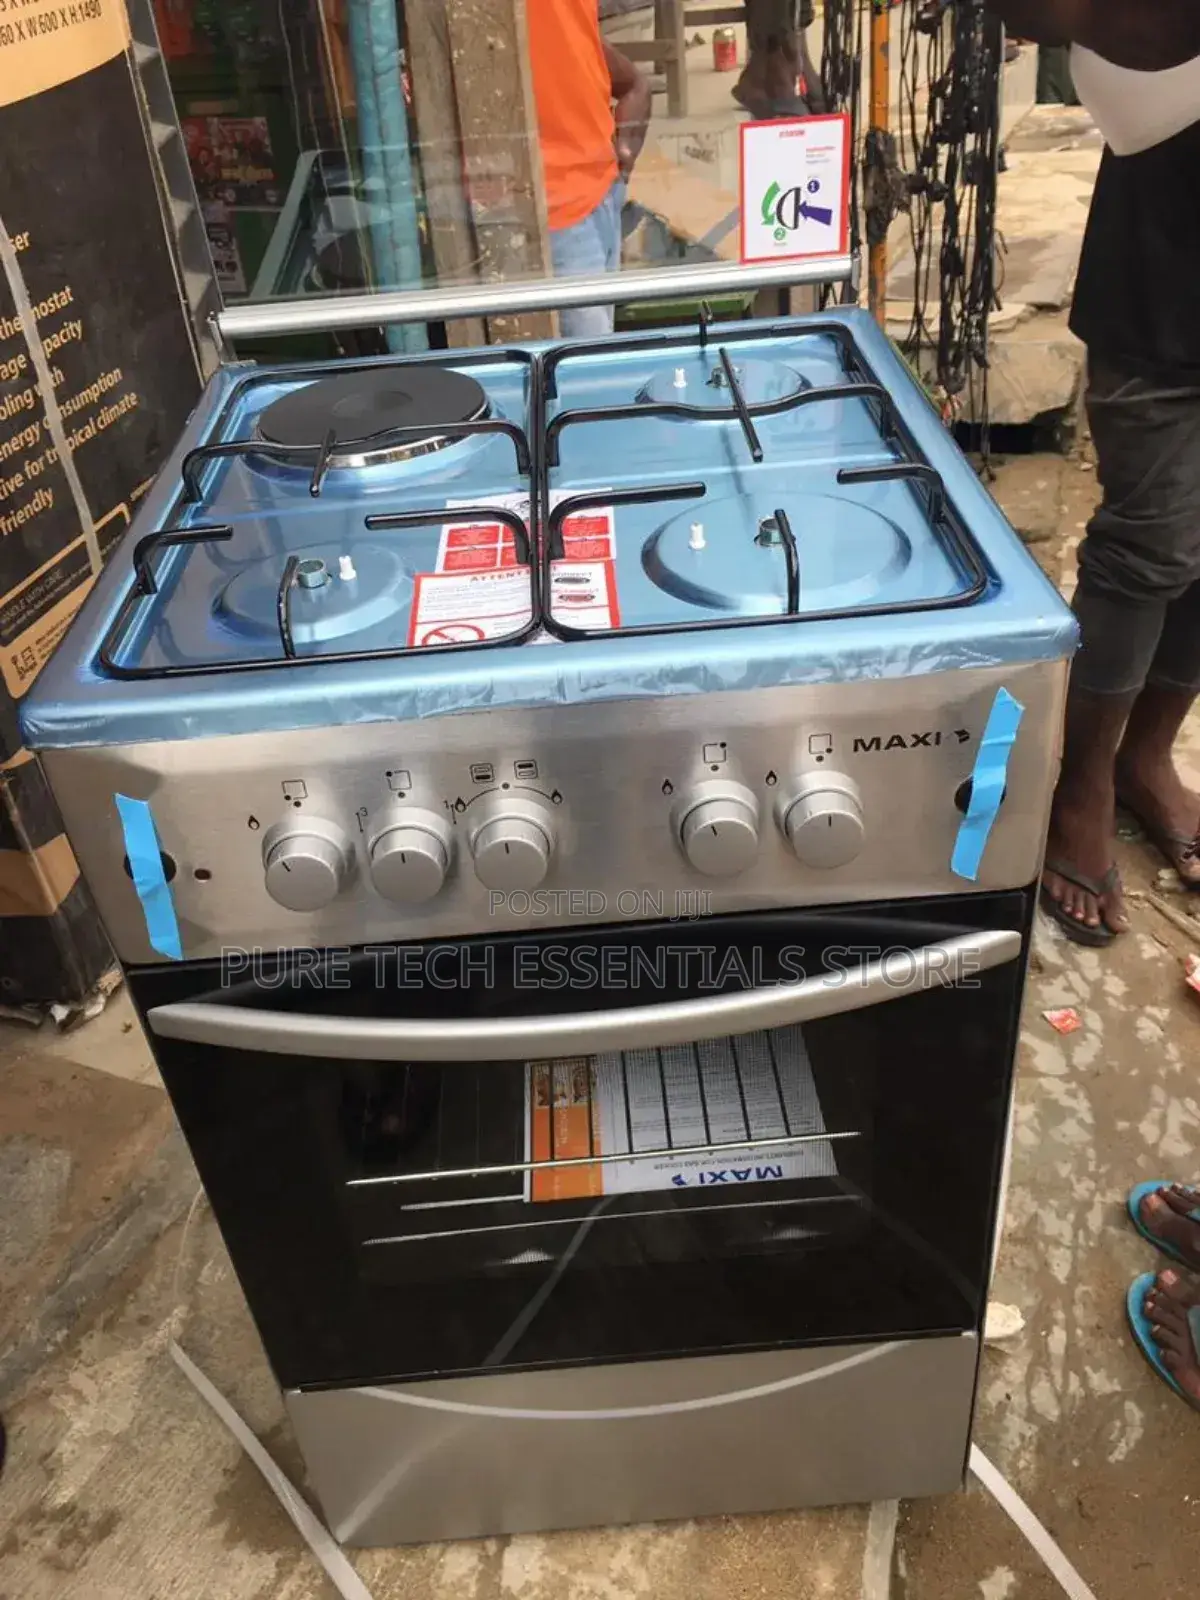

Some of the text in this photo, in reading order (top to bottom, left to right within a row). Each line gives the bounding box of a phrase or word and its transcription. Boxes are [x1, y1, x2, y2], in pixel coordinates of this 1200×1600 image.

[24, 456, 45, 480] for
[97, 392, 138, 430] climate
[0, 487, 53, 536] friendly
[853, 731, 942, 752] MAXI
[698, 1165, 784, 1185] MAXI
